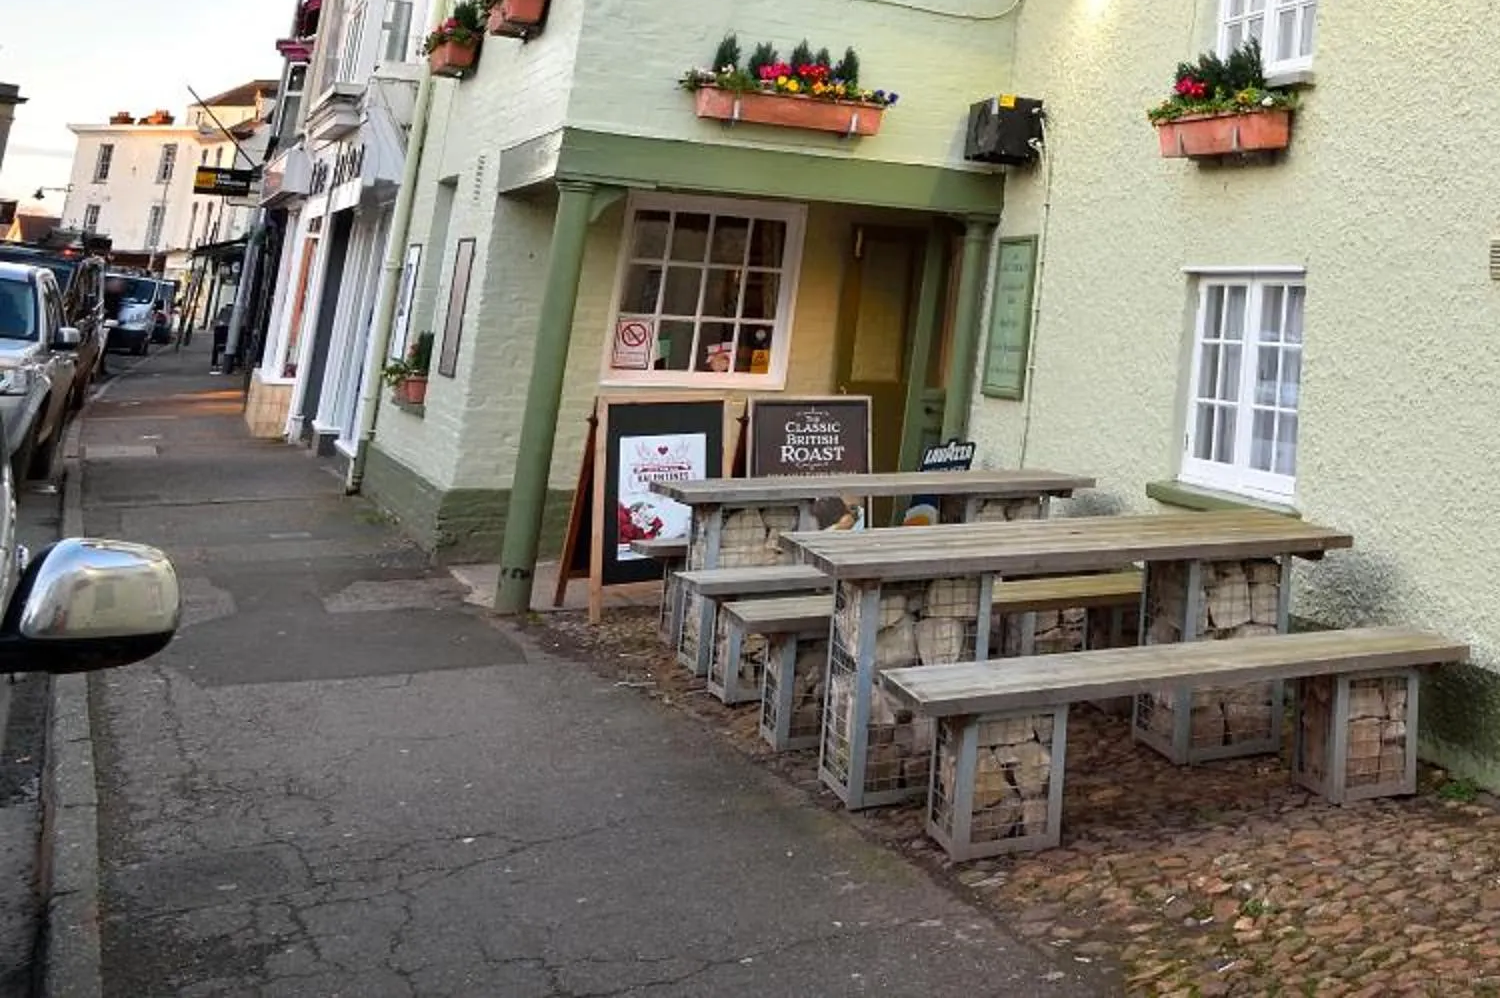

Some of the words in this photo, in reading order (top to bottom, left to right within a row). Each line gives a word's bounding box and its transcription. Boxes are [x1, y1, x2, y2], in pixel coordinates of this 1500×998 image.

[785, 421, 841, 433] CLASSIC
[786, 433, 839, 444] BRITISH
[780, 445, 845, 463] ROAST
